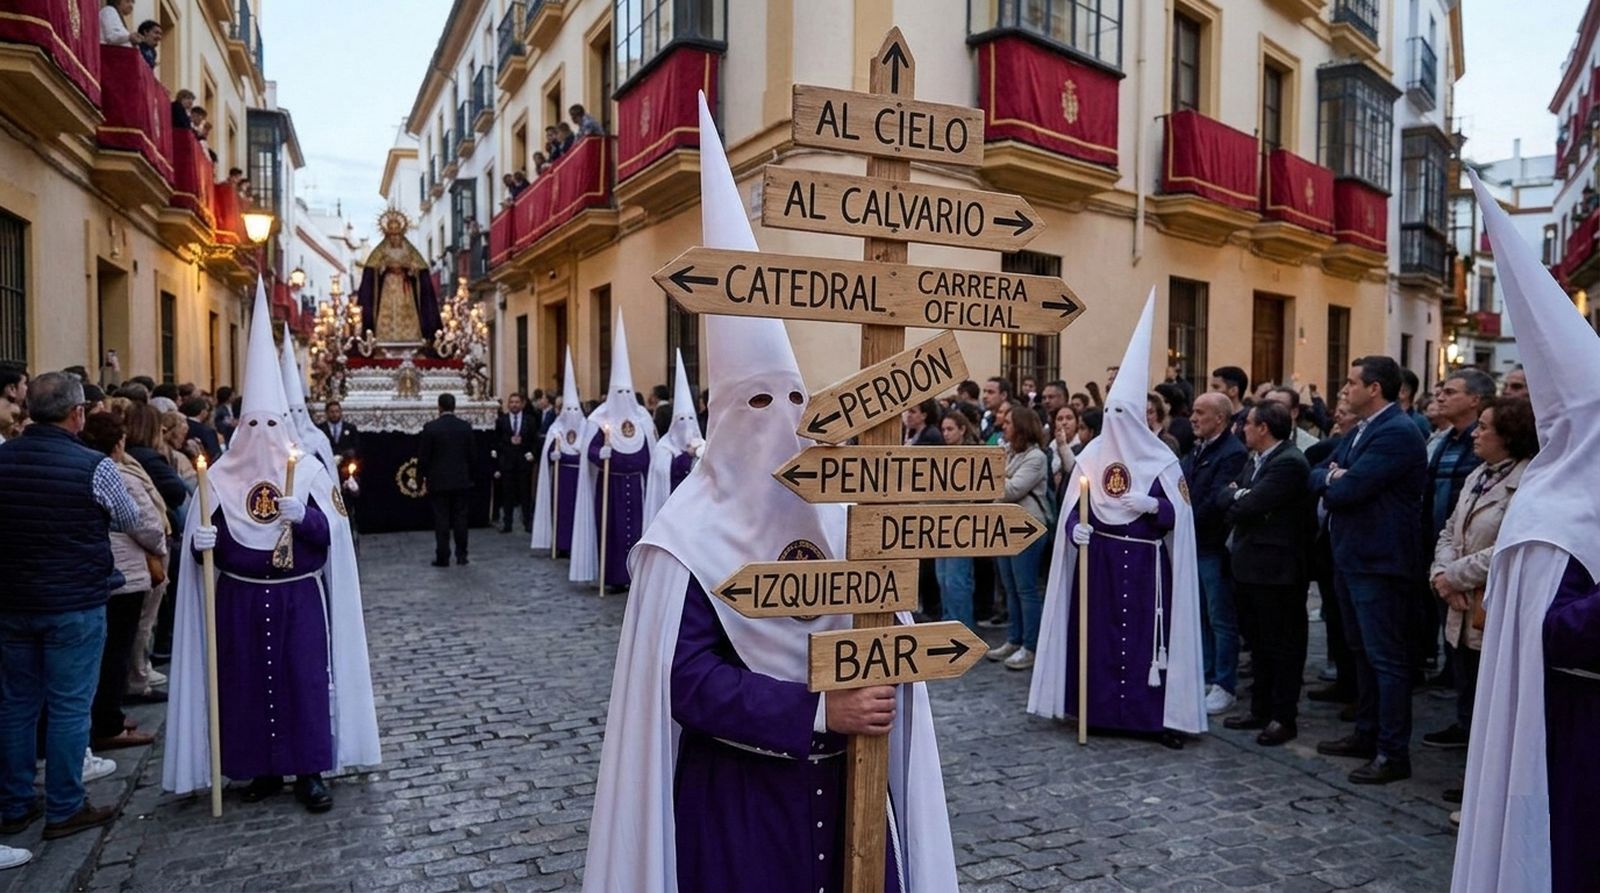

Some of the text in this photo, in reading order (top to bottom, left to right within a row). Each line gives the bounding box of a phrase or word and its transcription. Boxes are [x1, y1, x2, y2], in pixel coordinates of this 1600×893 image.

[815, 100, 968, 154] AL CIELO
[783, 180, 984, 237] AL CALVARIO
[725, 264, 887, 316] CATEDRAL
[918, 270, 1028, 302] CARRERA
[924, 299, 1020, 329] OFICIAL
[838, 347, 953, 428] PERDÓN
[821, 457, 995, 494] PENITENCIA
[881, 514, 1008, 550] DERECHA
[754, 570, 899, 609] IZQUIERDA
[835, 634, 919, 682] BAR
